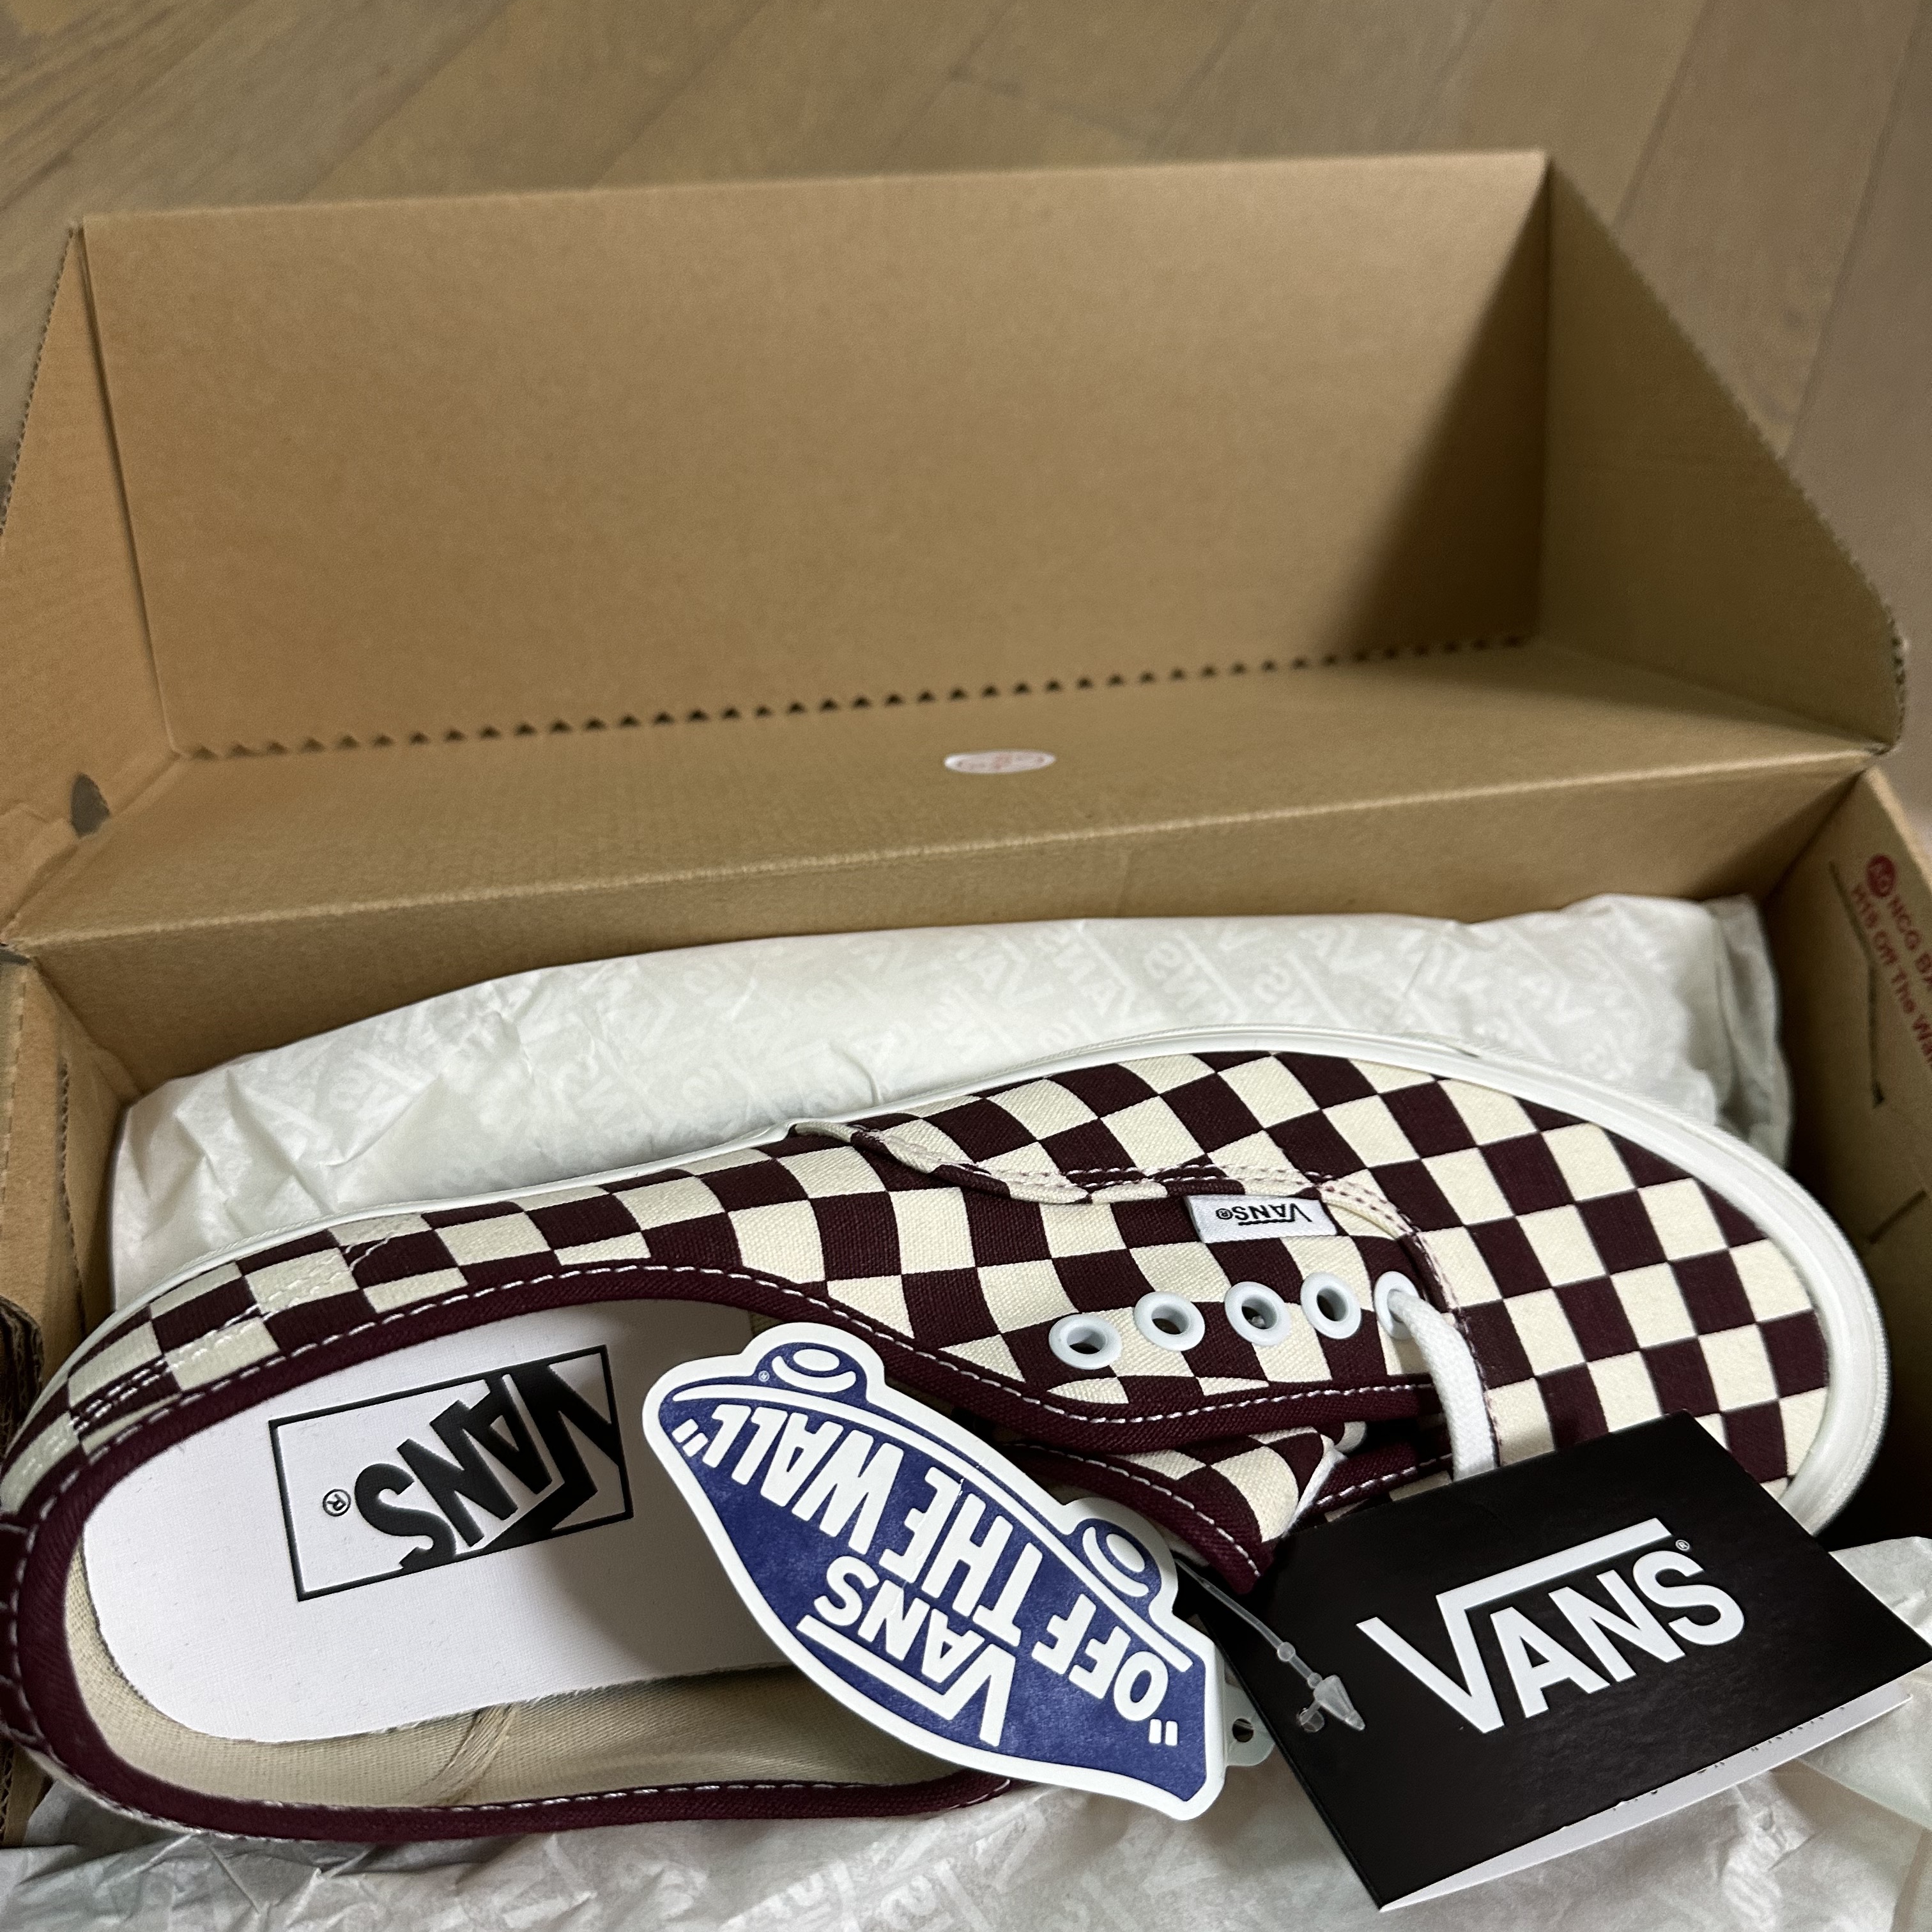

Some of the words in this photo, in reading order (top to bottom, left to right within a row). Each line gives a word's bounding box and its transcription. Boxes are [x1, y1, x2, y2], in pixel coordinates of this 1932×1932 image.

[1892, 966, 1917, 1014] The
[1232, 1202, 1312, 1226] VANS
[355, 1363, 622, 1569] VANS
[671, 1404, 905, 1555] WALL"
[880, 1467, 1043, 1646] THE
[1356, 1517, 1745, 1734] VANS
[796, 1555, 1016, 1747] VANS
[1032, 1594, 1179, 1747] "OFF
